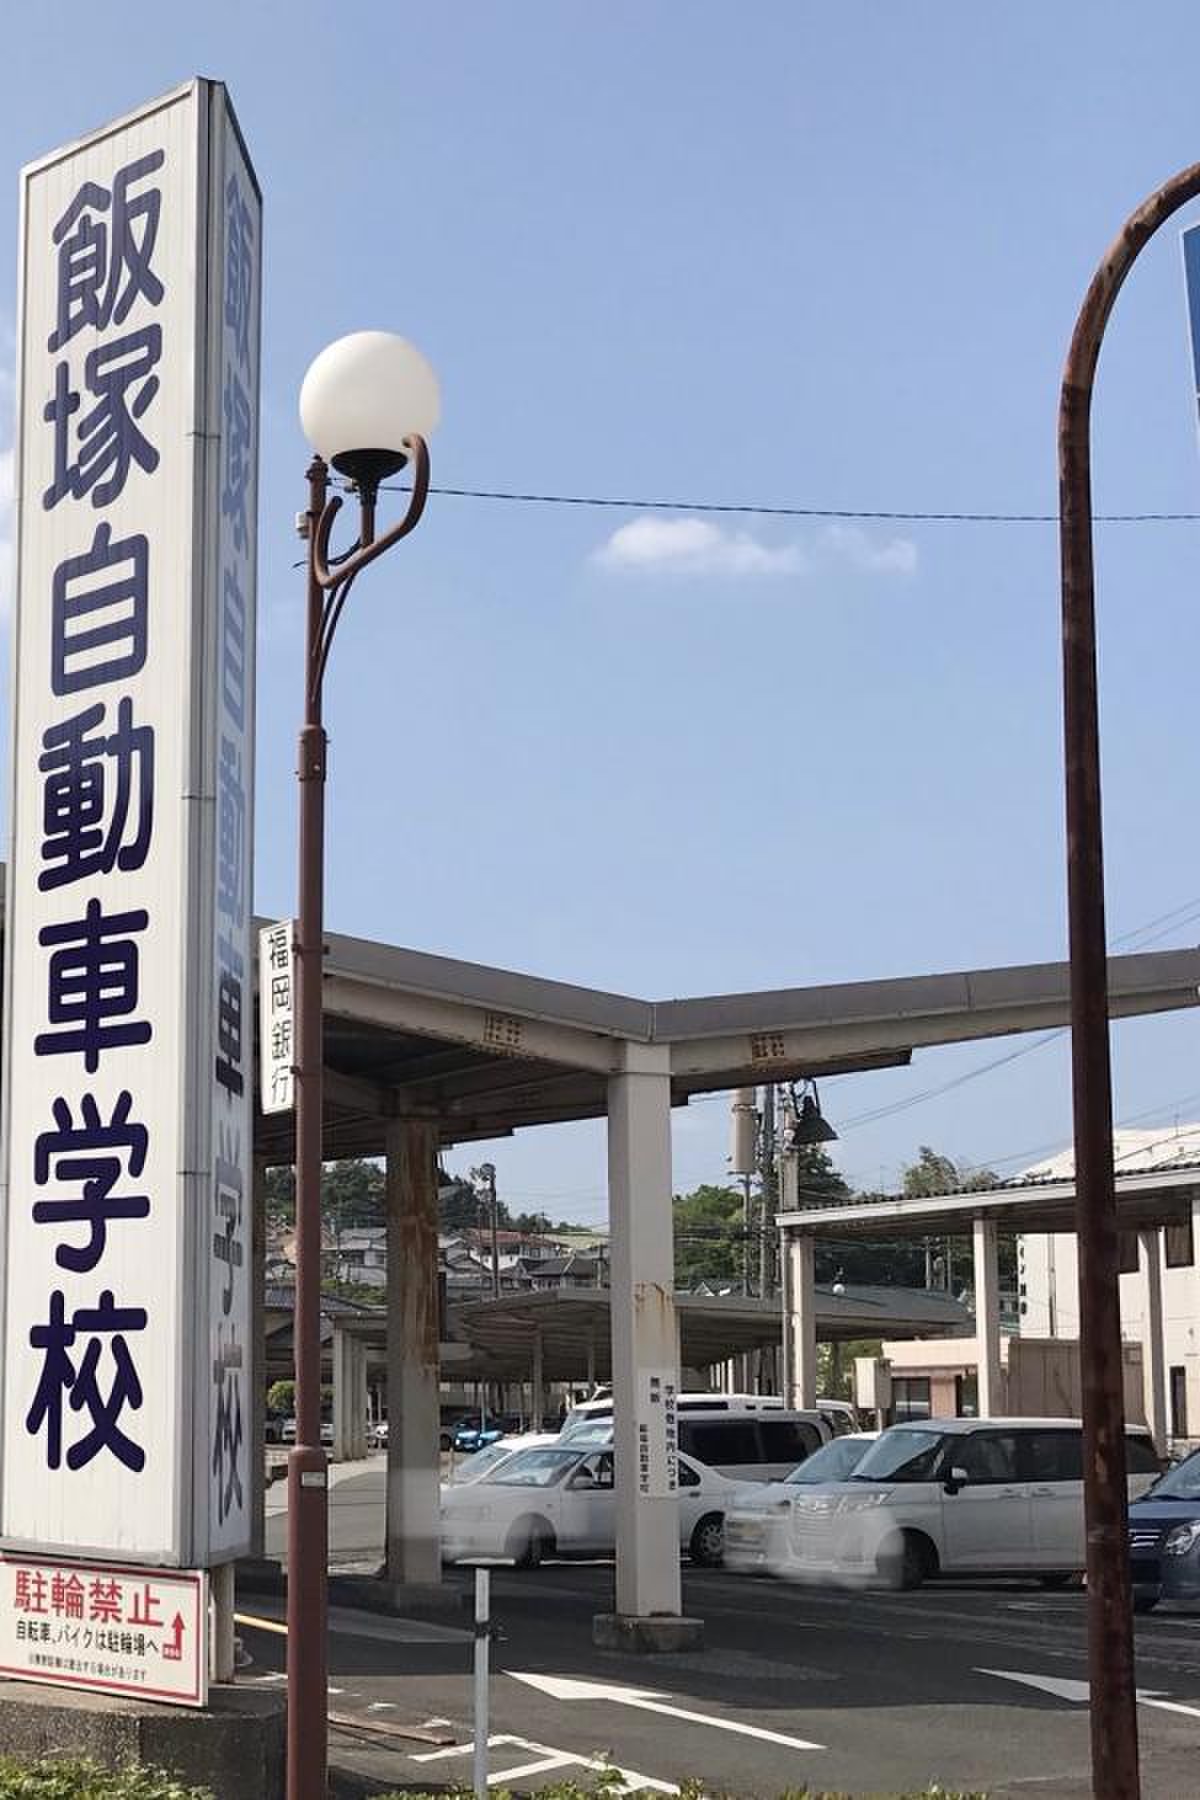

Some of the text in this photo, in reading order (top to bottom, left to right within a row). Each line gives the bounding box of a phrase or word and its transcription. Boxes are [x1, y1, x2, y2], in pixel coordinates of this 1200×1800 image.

[26, 148, 164, 1472] 飯塚自動車学校
[212, 174, 253, 1527] 飯塚自動車学校
[267, 929, 291, 1105] 福岡銀行
[14, 1569, 164, 1627] 駐輪禁止
[16, 1619, 159, 1657] 自転車、バイクは駐輪場へ
